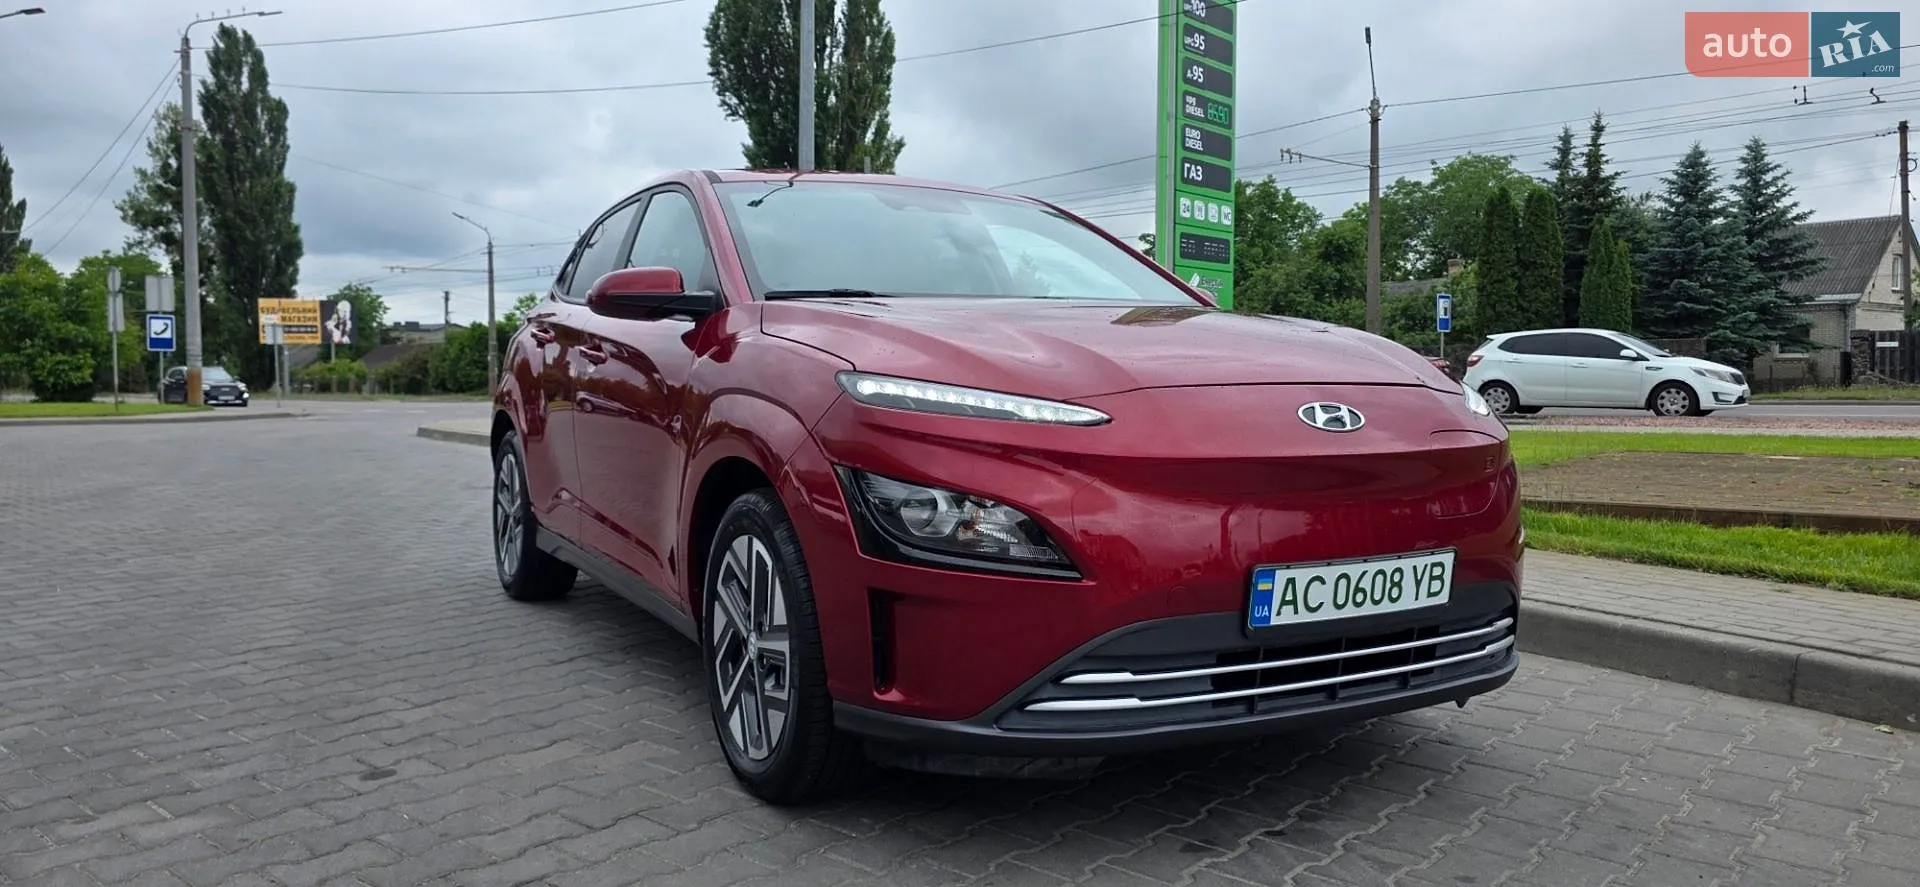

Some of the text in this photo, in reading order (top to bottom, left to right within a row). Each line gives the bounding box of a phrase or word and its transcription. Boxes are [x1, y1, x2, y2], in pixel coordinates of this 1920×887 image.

[1185, 104, 1205, 118] DIESEL
[1185, 127, 1201, 140] EURO
[1185, 138, 1204, 151] DIESEL
[1184, 163, 1203, 181] ГАЗ
[1182, 203, 1190, 214] 24
[1275, 560, 1447, 617] AC 0608 YB
[1254, 604, 1270, 618] UA
